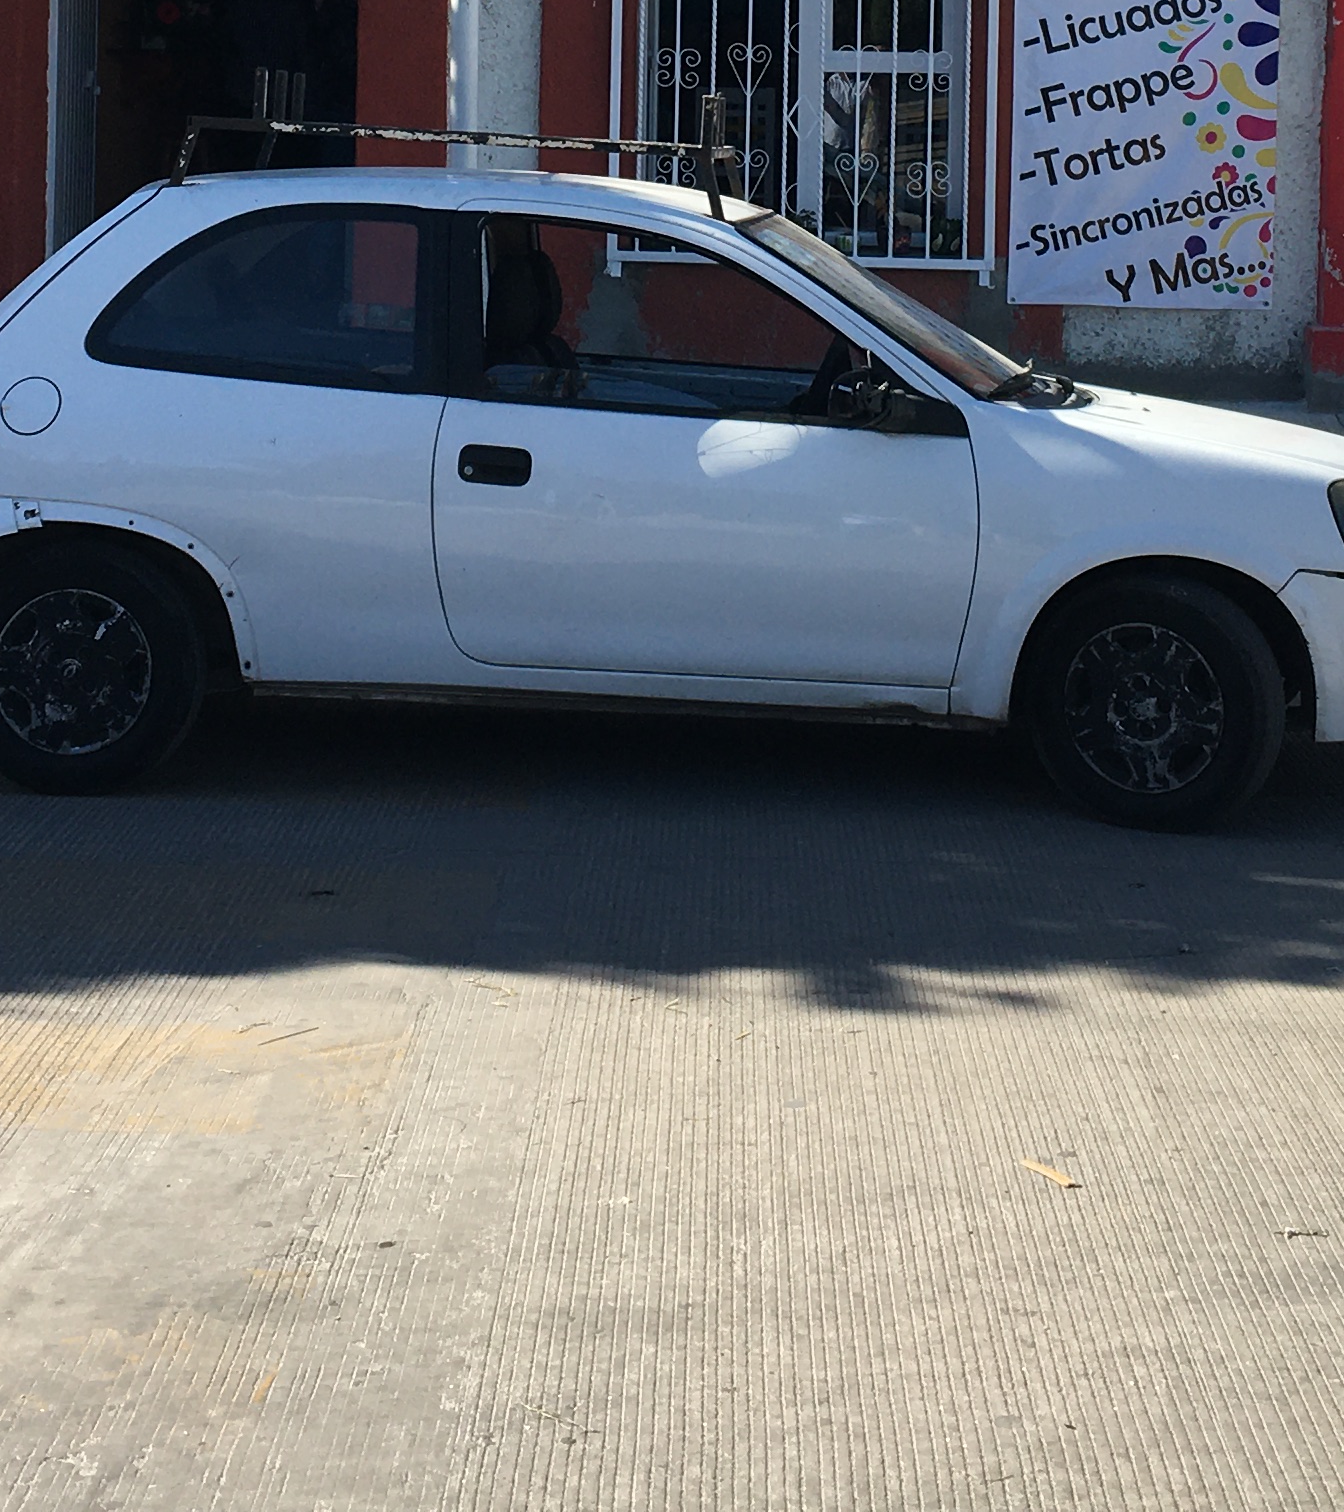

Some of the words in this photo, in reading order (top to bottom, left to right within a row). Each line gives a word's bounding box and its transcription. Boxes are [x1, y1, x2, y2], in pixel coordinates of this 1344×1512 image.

[1024, 63, 1196, 123] -Frappe
[1019, 134, 1166, 186] -Tortas
[1016, 179, 1263, 256] -Sincronizadas
[1105, 264, 1136, 303] Y
[1148, 252, 1266, 294] Mas...
